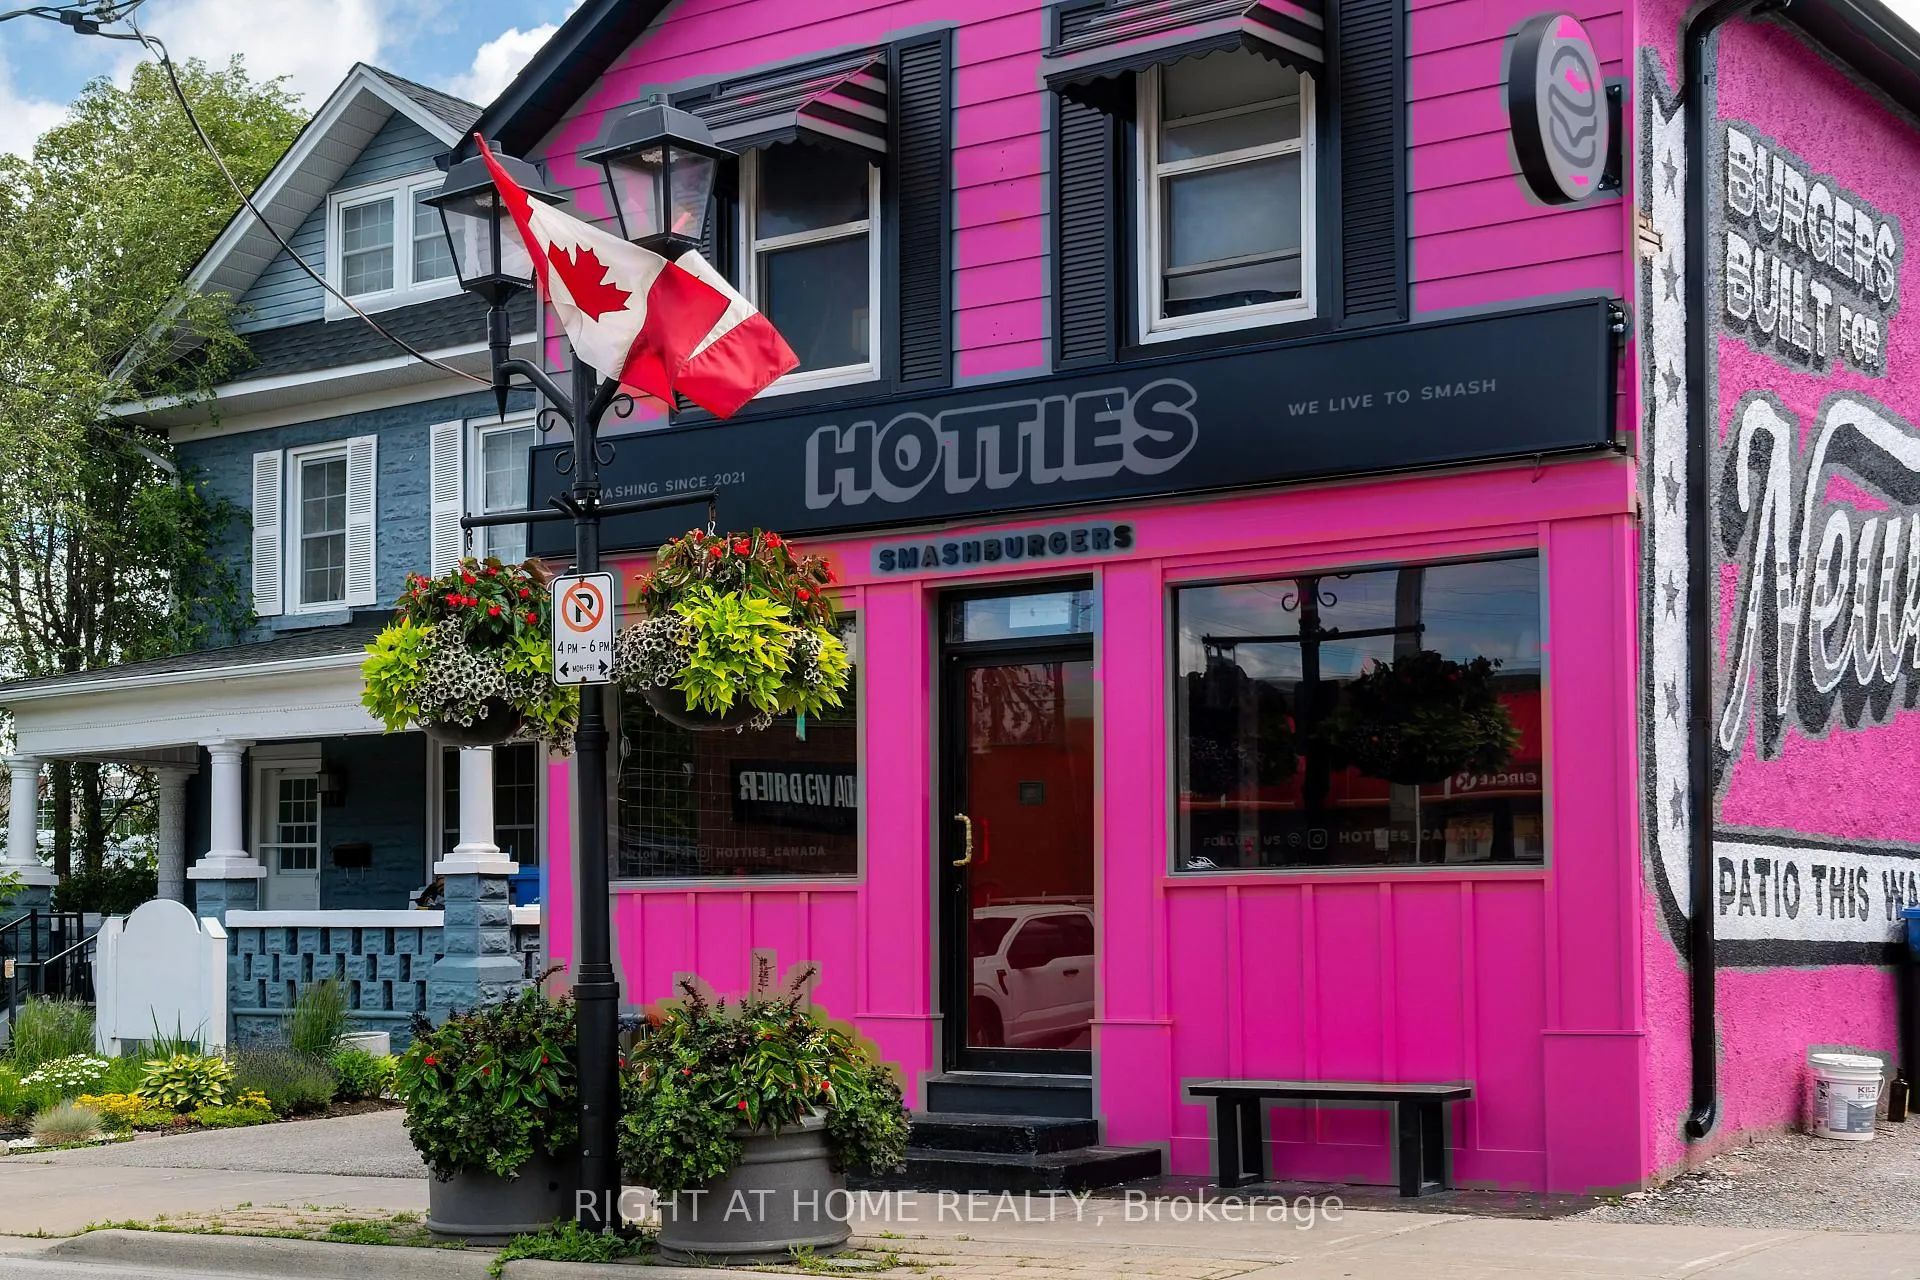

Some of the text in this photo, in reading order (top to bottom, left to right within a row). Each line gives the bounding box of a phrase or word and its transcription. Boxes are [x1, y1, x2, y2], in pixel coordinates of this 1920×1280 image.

[1726, 127, 1897, 303] BURGERS
[1726, 231, 1880, 367] BUILT FOR
[1288, 379, 1497, 416] WE LIVE TO SMASH
[806, 377, 1199, 510] HOTTIES
[665, 476, 707, 491] SINCE
[714, 472, 745, 487] 2021
[878, 524, 1132, 572] SMASHBURGERS
[557, 641, 564, 655] 4
[567, 643, 578, 654] PM
[589, 639, 596, 653] 6
[599, 641, 610, 652] PM
[572, 663, 595, 673] MON-FRI
[1718, 856, 1800, 920] PATIO
[1812, 864, 1870, 922] THIS
